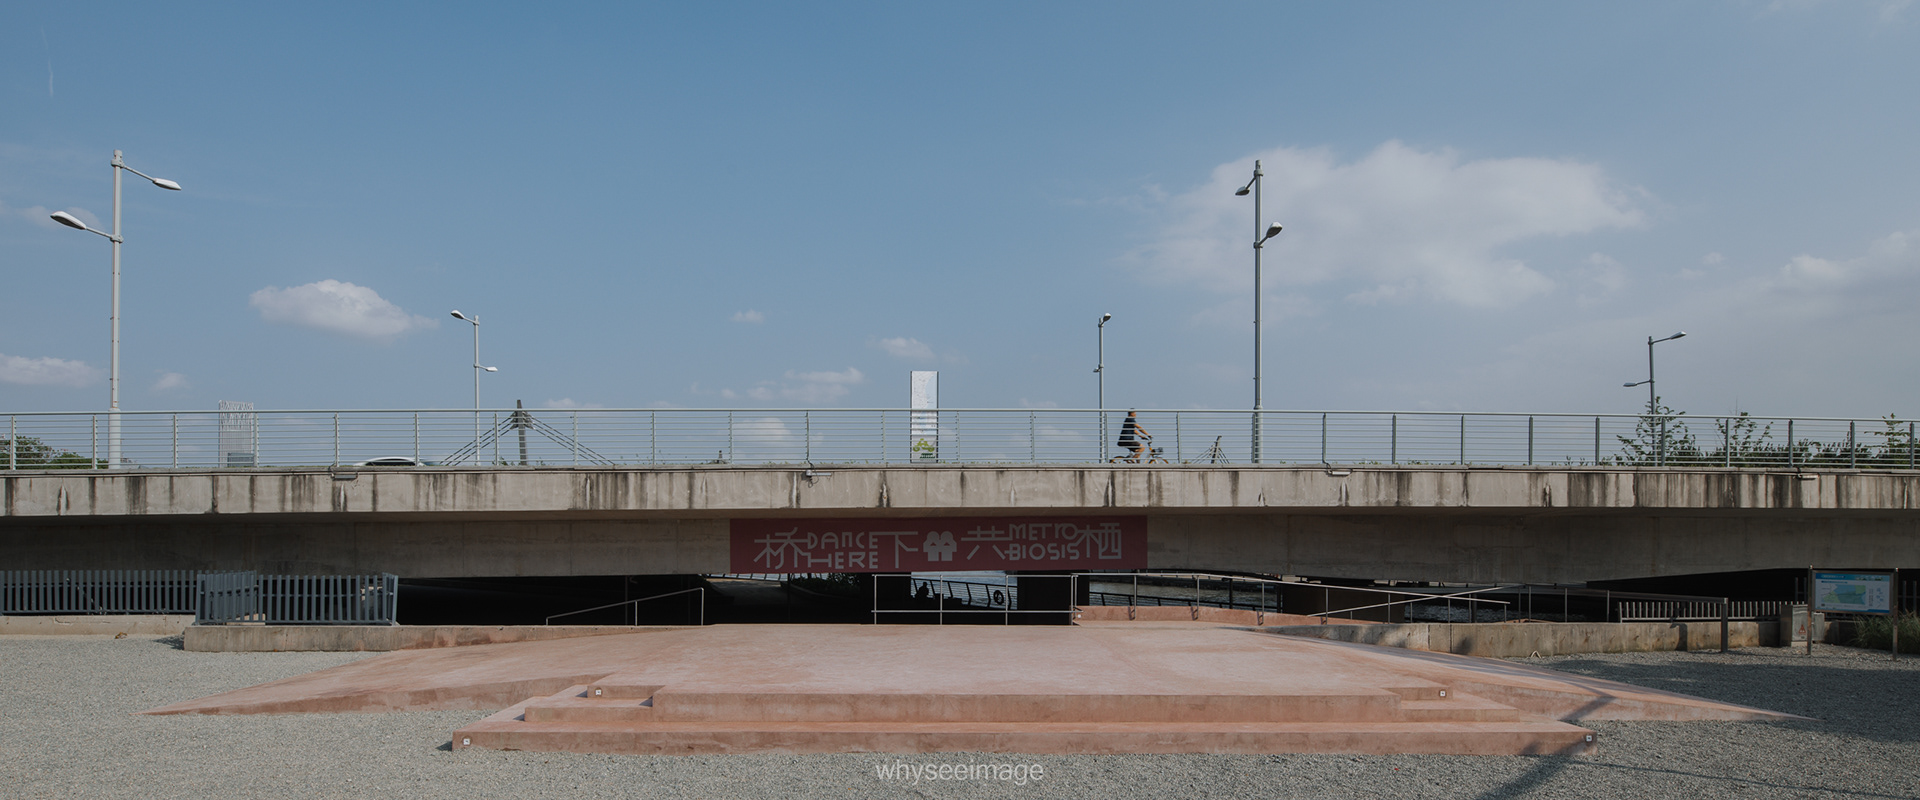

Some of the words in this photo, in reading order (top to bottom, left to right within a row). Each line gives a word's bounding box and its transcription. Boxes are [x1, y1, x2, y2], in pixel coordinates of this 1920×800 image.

[753, 527, 809, 569] 桥
[874, 531, 918, 569] 下
[961, 525, 1007, 561] 共
[1076, 523, 1122, 560] 栖
[807, 531, 878, 549] DANCE
[807, 551, 878, 569] HERE
[1007, 543, 1080, 561] BIOSIS
